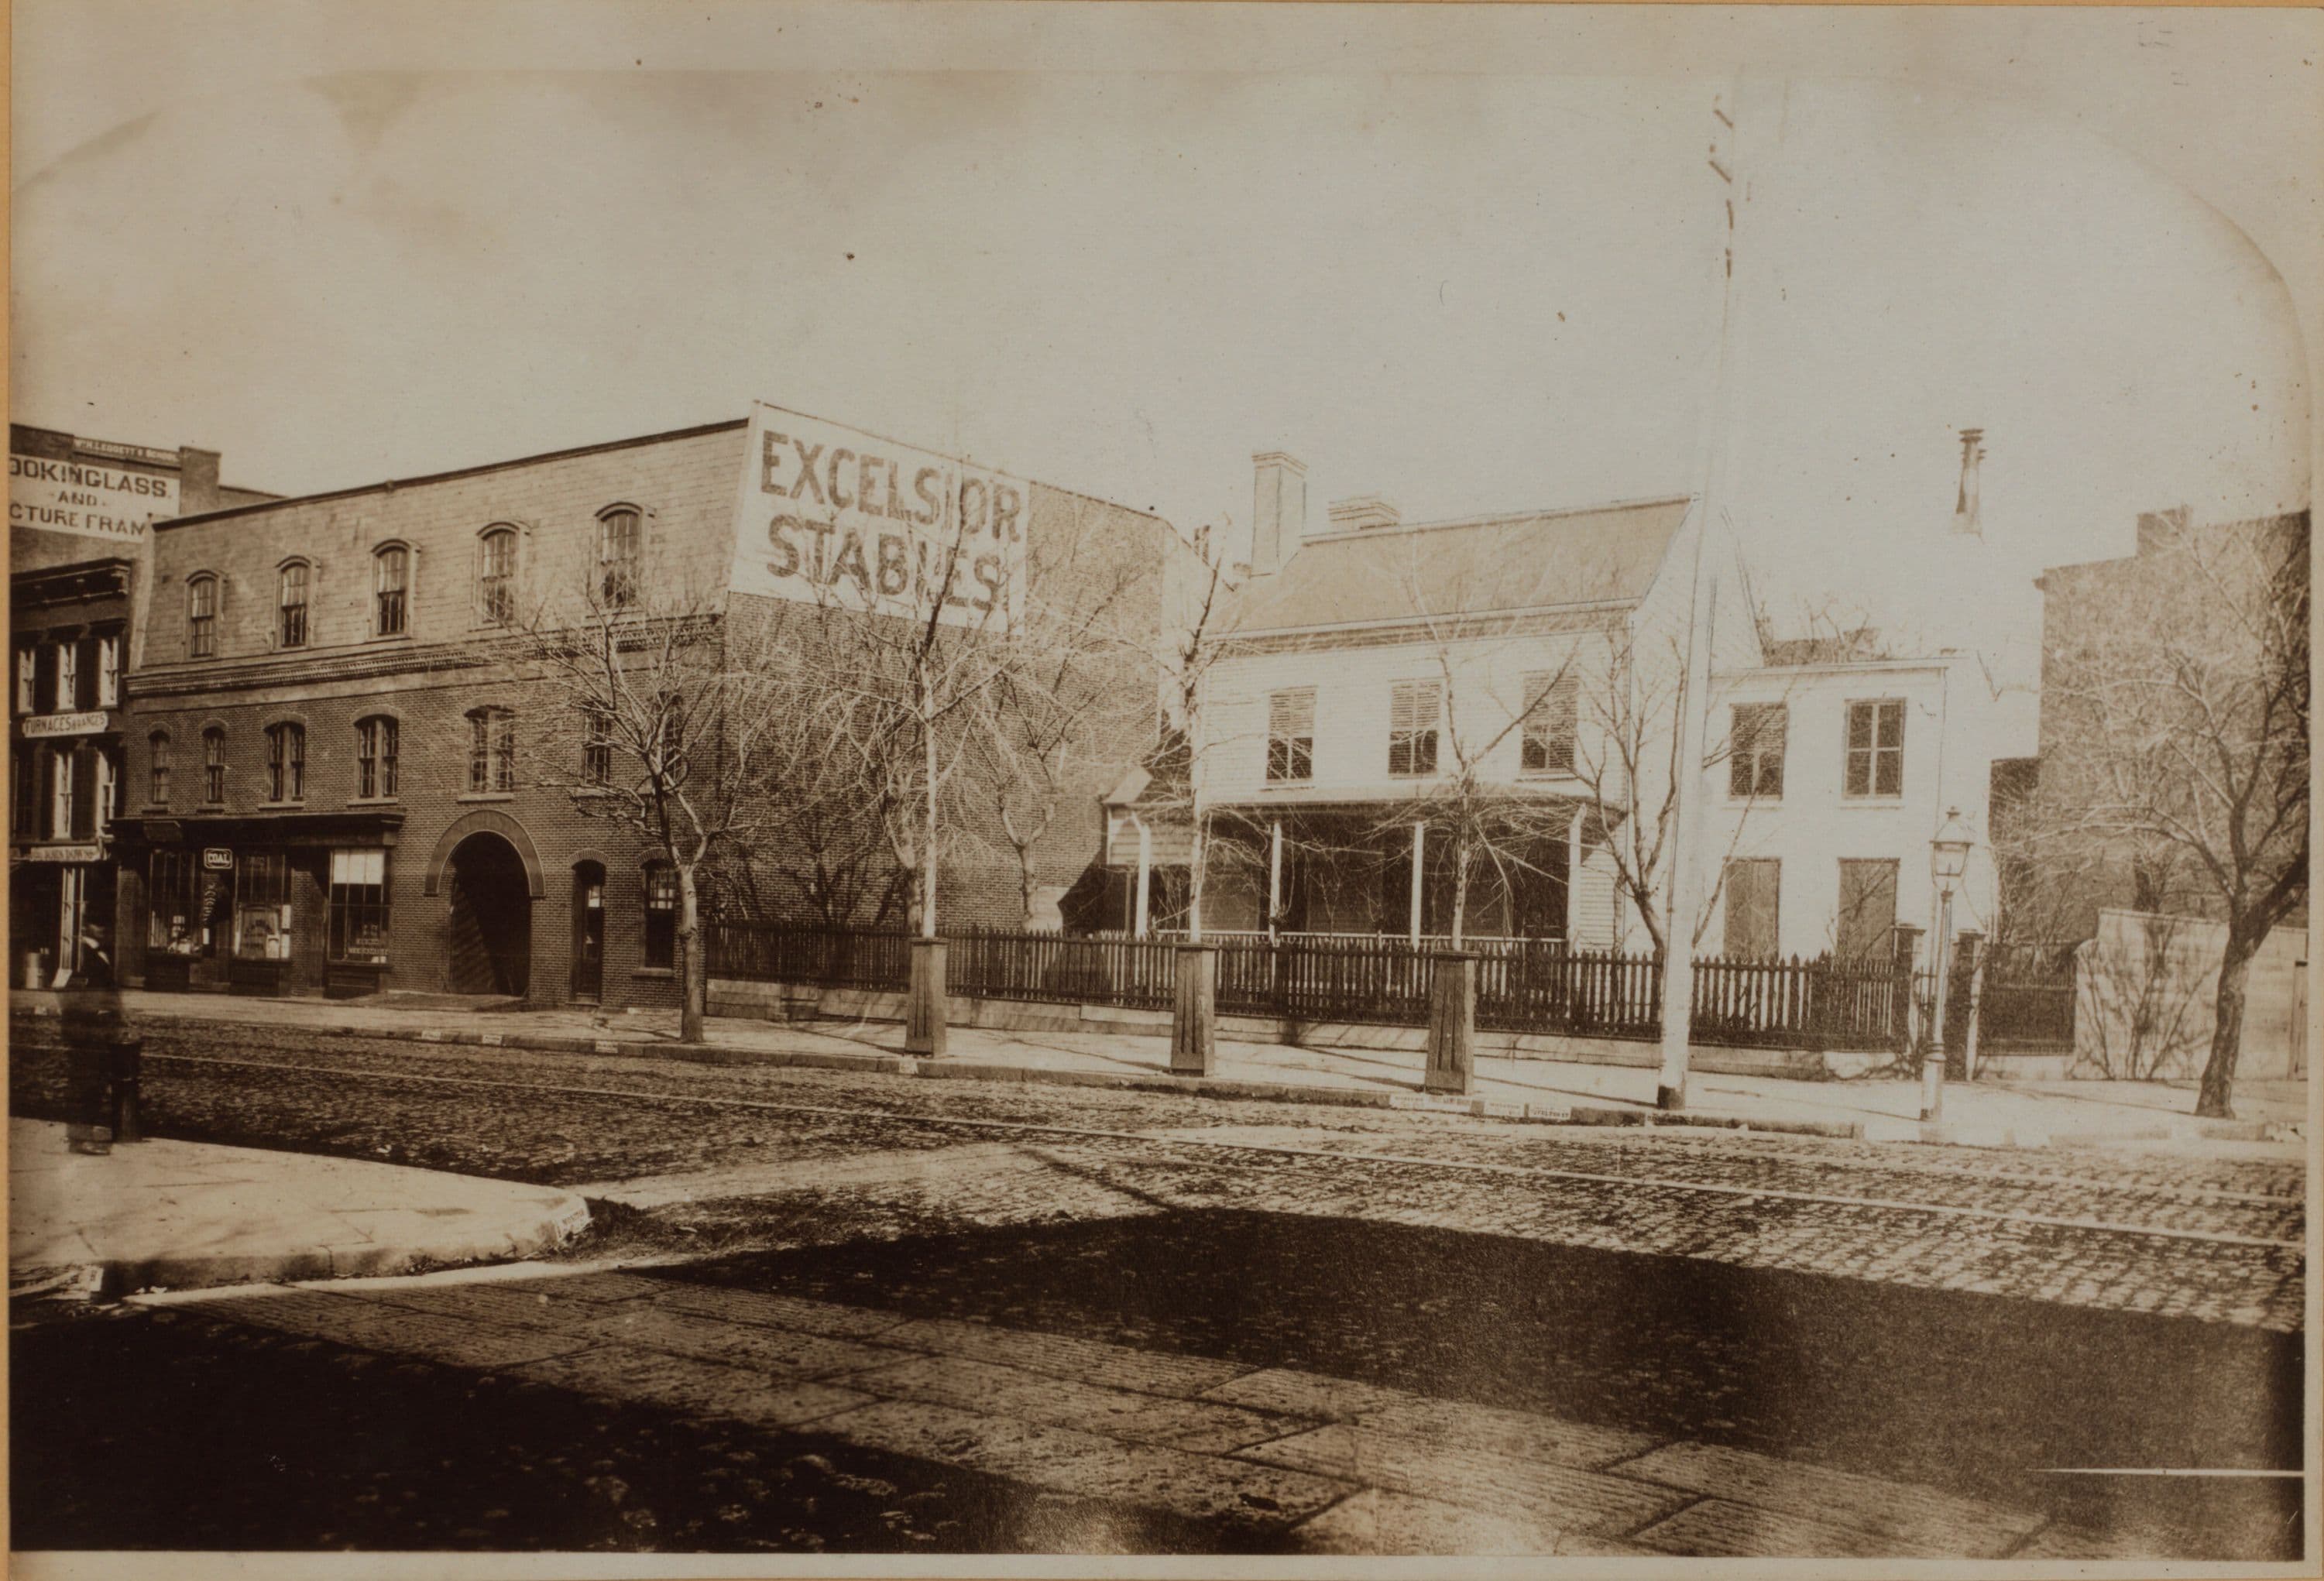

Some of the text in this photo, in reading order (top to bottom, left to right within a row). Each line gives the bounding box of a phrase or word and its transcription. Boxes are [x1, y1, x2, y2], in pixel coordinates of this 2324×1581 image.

[58, 490, 98, 506] AND
[761, 430, 1021, 543] EXCELSIOR
[767, 513, 1008, 611] STABLES
[208, 852, 230, 864] COAL
